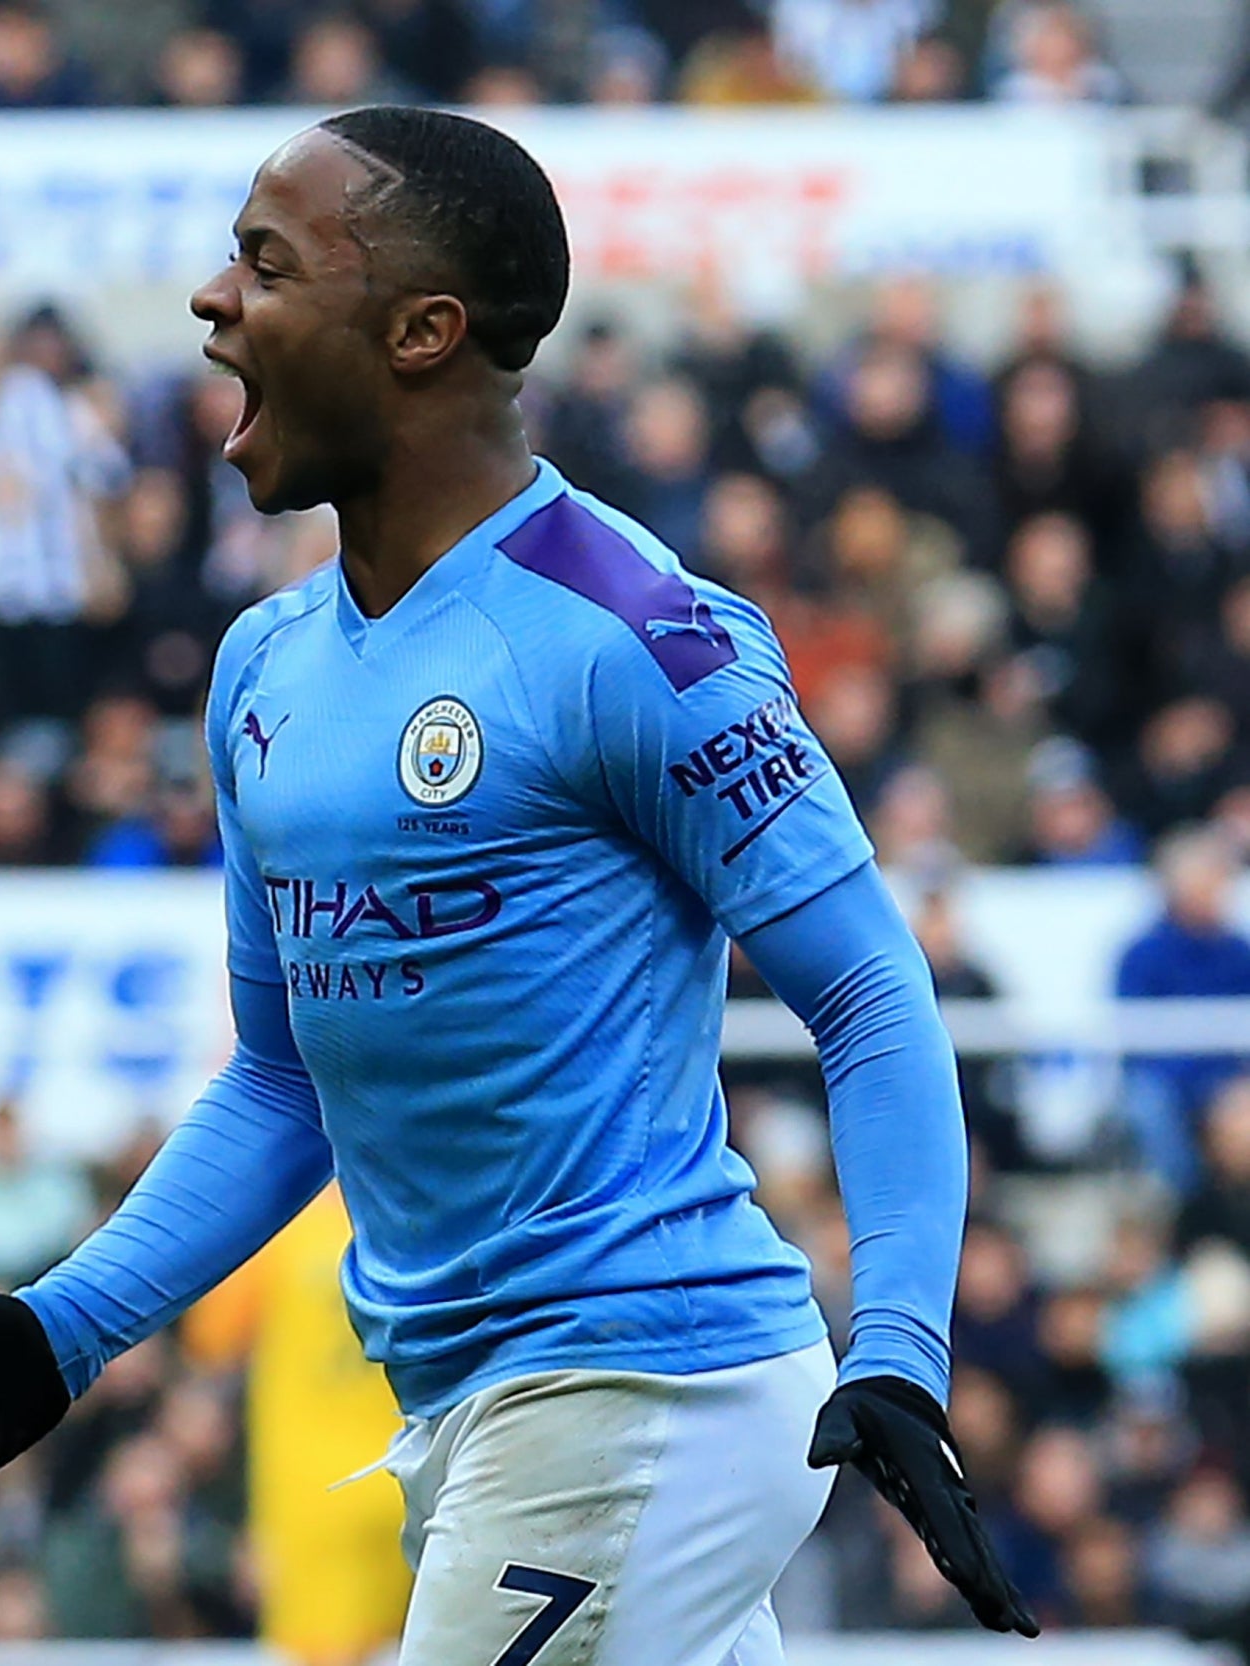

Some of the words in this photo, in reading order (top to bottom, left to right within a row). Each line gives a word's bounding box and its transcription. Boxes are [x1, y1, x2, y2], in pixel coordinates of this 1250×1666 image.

[411, 704, 474, 738] MANCHESTER
[420, 788, 448, 799] CITY
[397, 817, 419, 831] 125
[424, 821, 469, 834] YEARS
[263, 875, 502, 940] TIHAD
[289, 960, 426, 1000] RWAYS
[494, 1560, 600, 1666] 7
